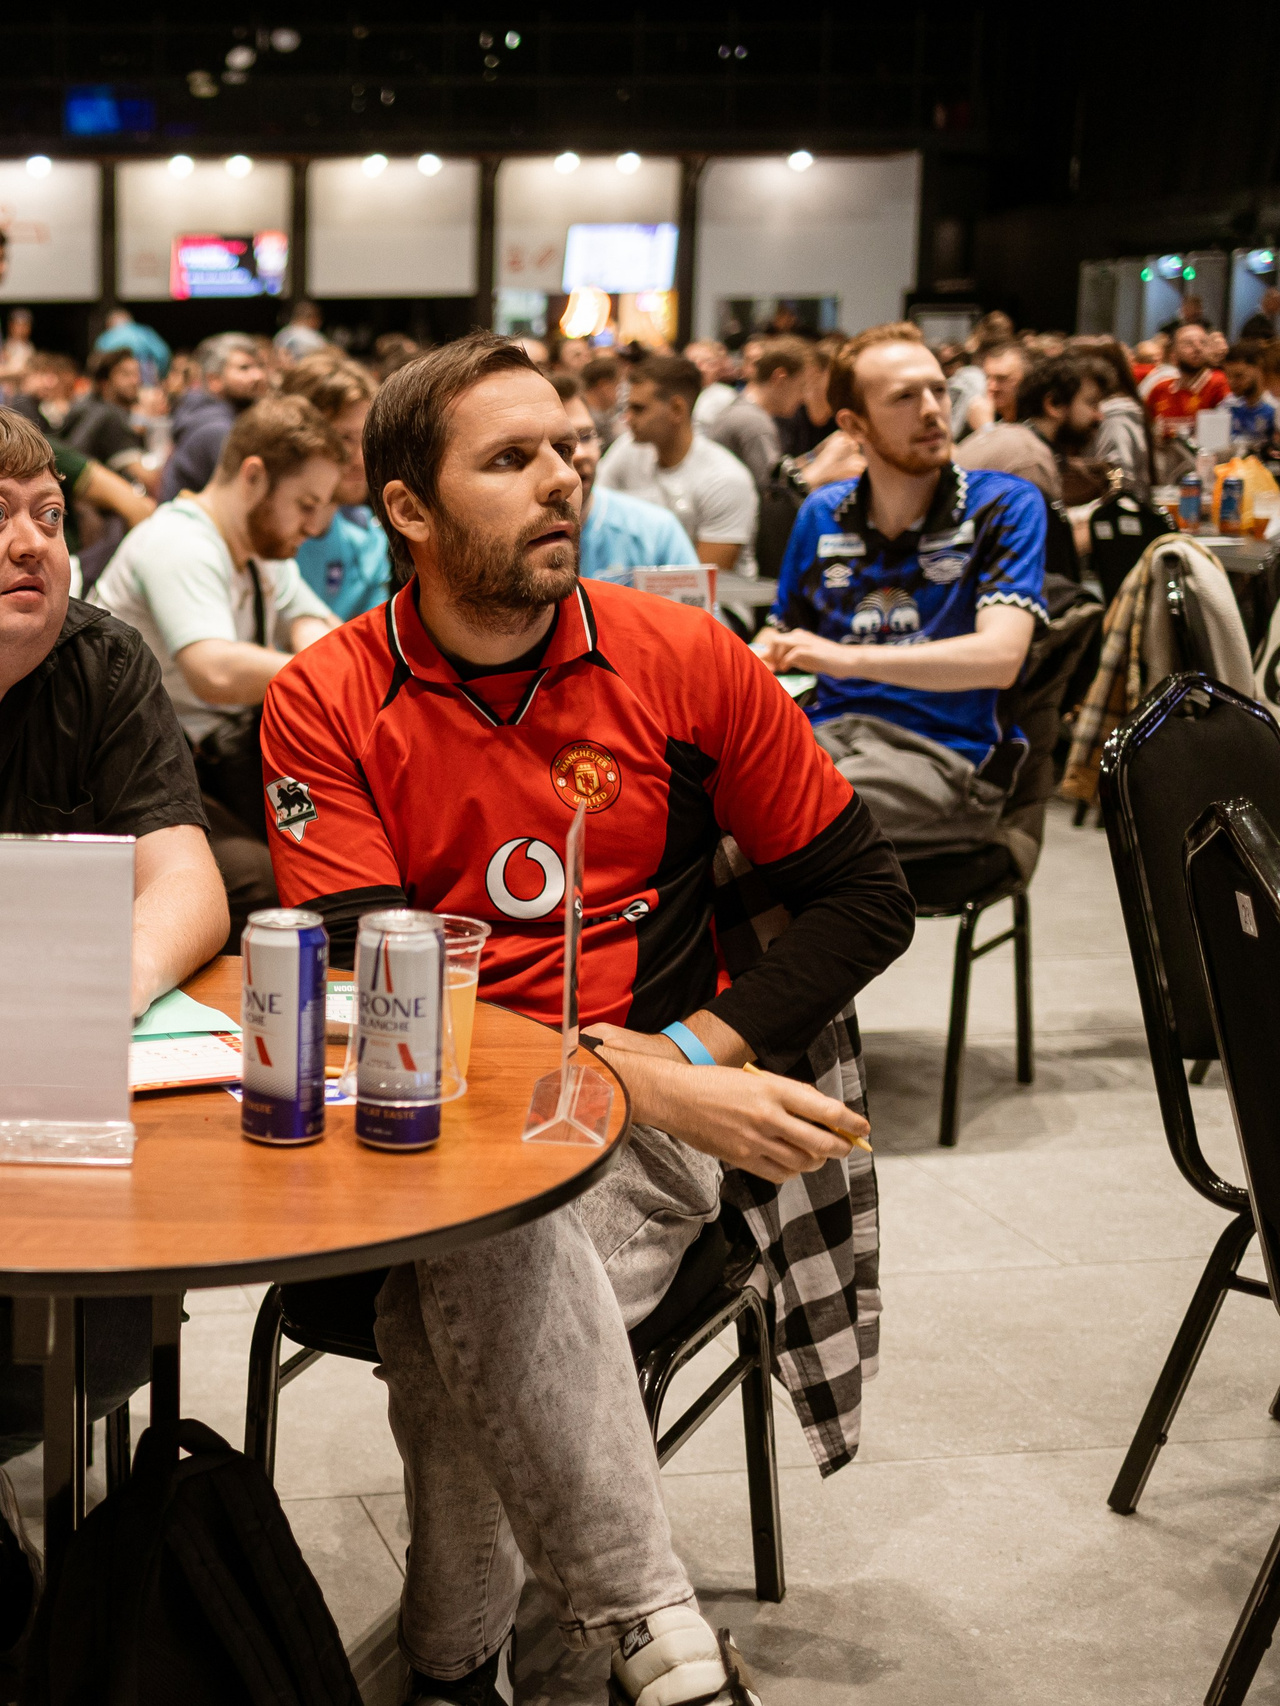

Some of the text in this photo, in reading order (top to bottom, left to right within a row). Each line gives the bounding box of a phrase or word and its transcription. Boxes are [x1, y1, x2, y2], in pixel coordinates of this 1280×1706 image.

[560, 750, 607, 772] MANCHESTER
[573, 791, 607, 805] UNITED
[625, 1627, 639, 1646] NIKE
[638, 1632, 651, 1648] AIR
